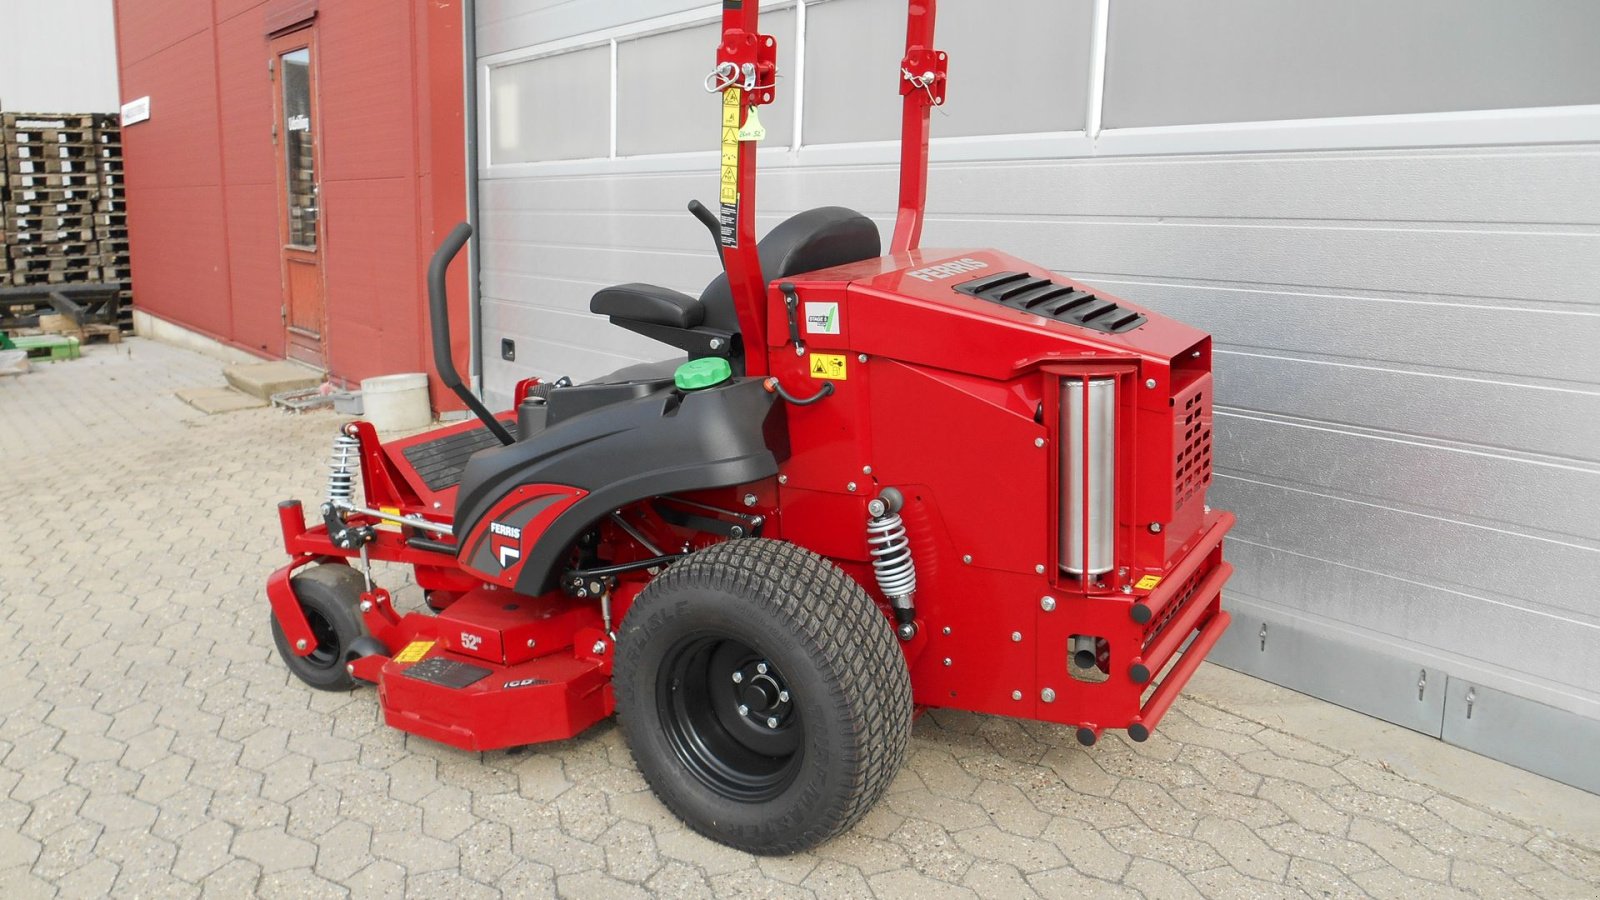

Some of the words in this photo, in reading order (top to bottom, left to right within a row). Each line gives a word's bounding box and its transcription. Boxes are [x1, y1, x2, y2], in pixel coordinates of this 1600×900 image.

[906, 258, 989, 282] FERRIS
[490, 521, 521, 539] FERRIS
[461, 632, 482, 651] 52"
[728, 782, 821, 838] MASTER
